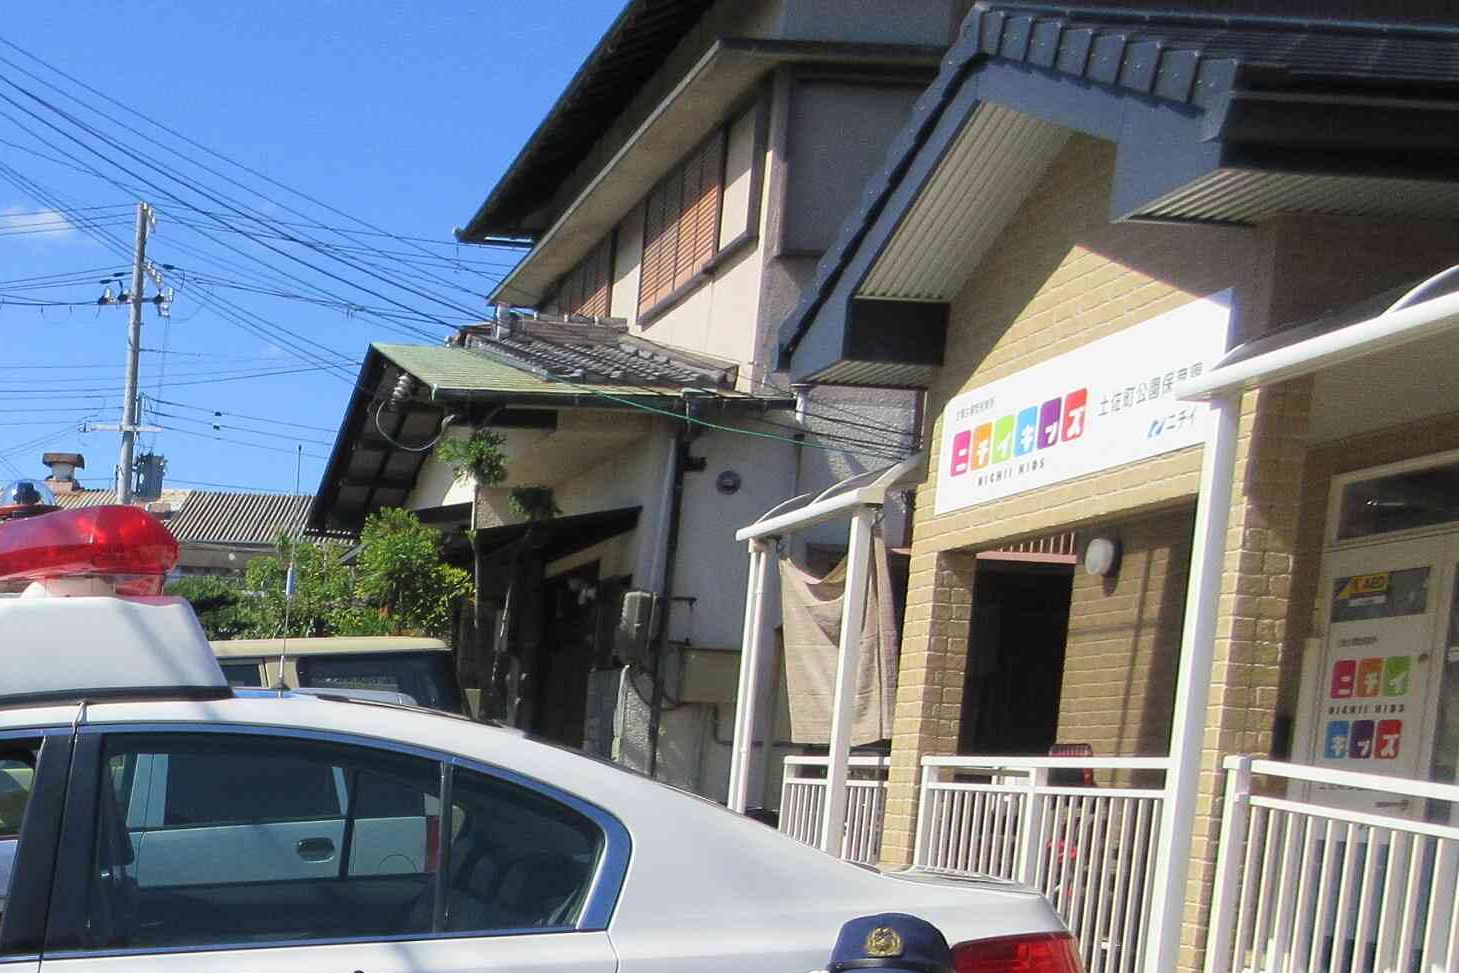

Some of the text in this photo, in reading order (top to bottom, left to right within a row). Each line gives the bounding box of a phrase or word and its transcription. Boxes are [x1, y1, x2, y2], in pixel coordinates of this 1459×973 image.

[951, 396, 1086, 475] ニチイキッズ
[977, 457, 1046, 487] NICHII KIDS
[1333, 664, 1410, 697] ニチイ
[1327, 726, 1400, 757] キッズ
